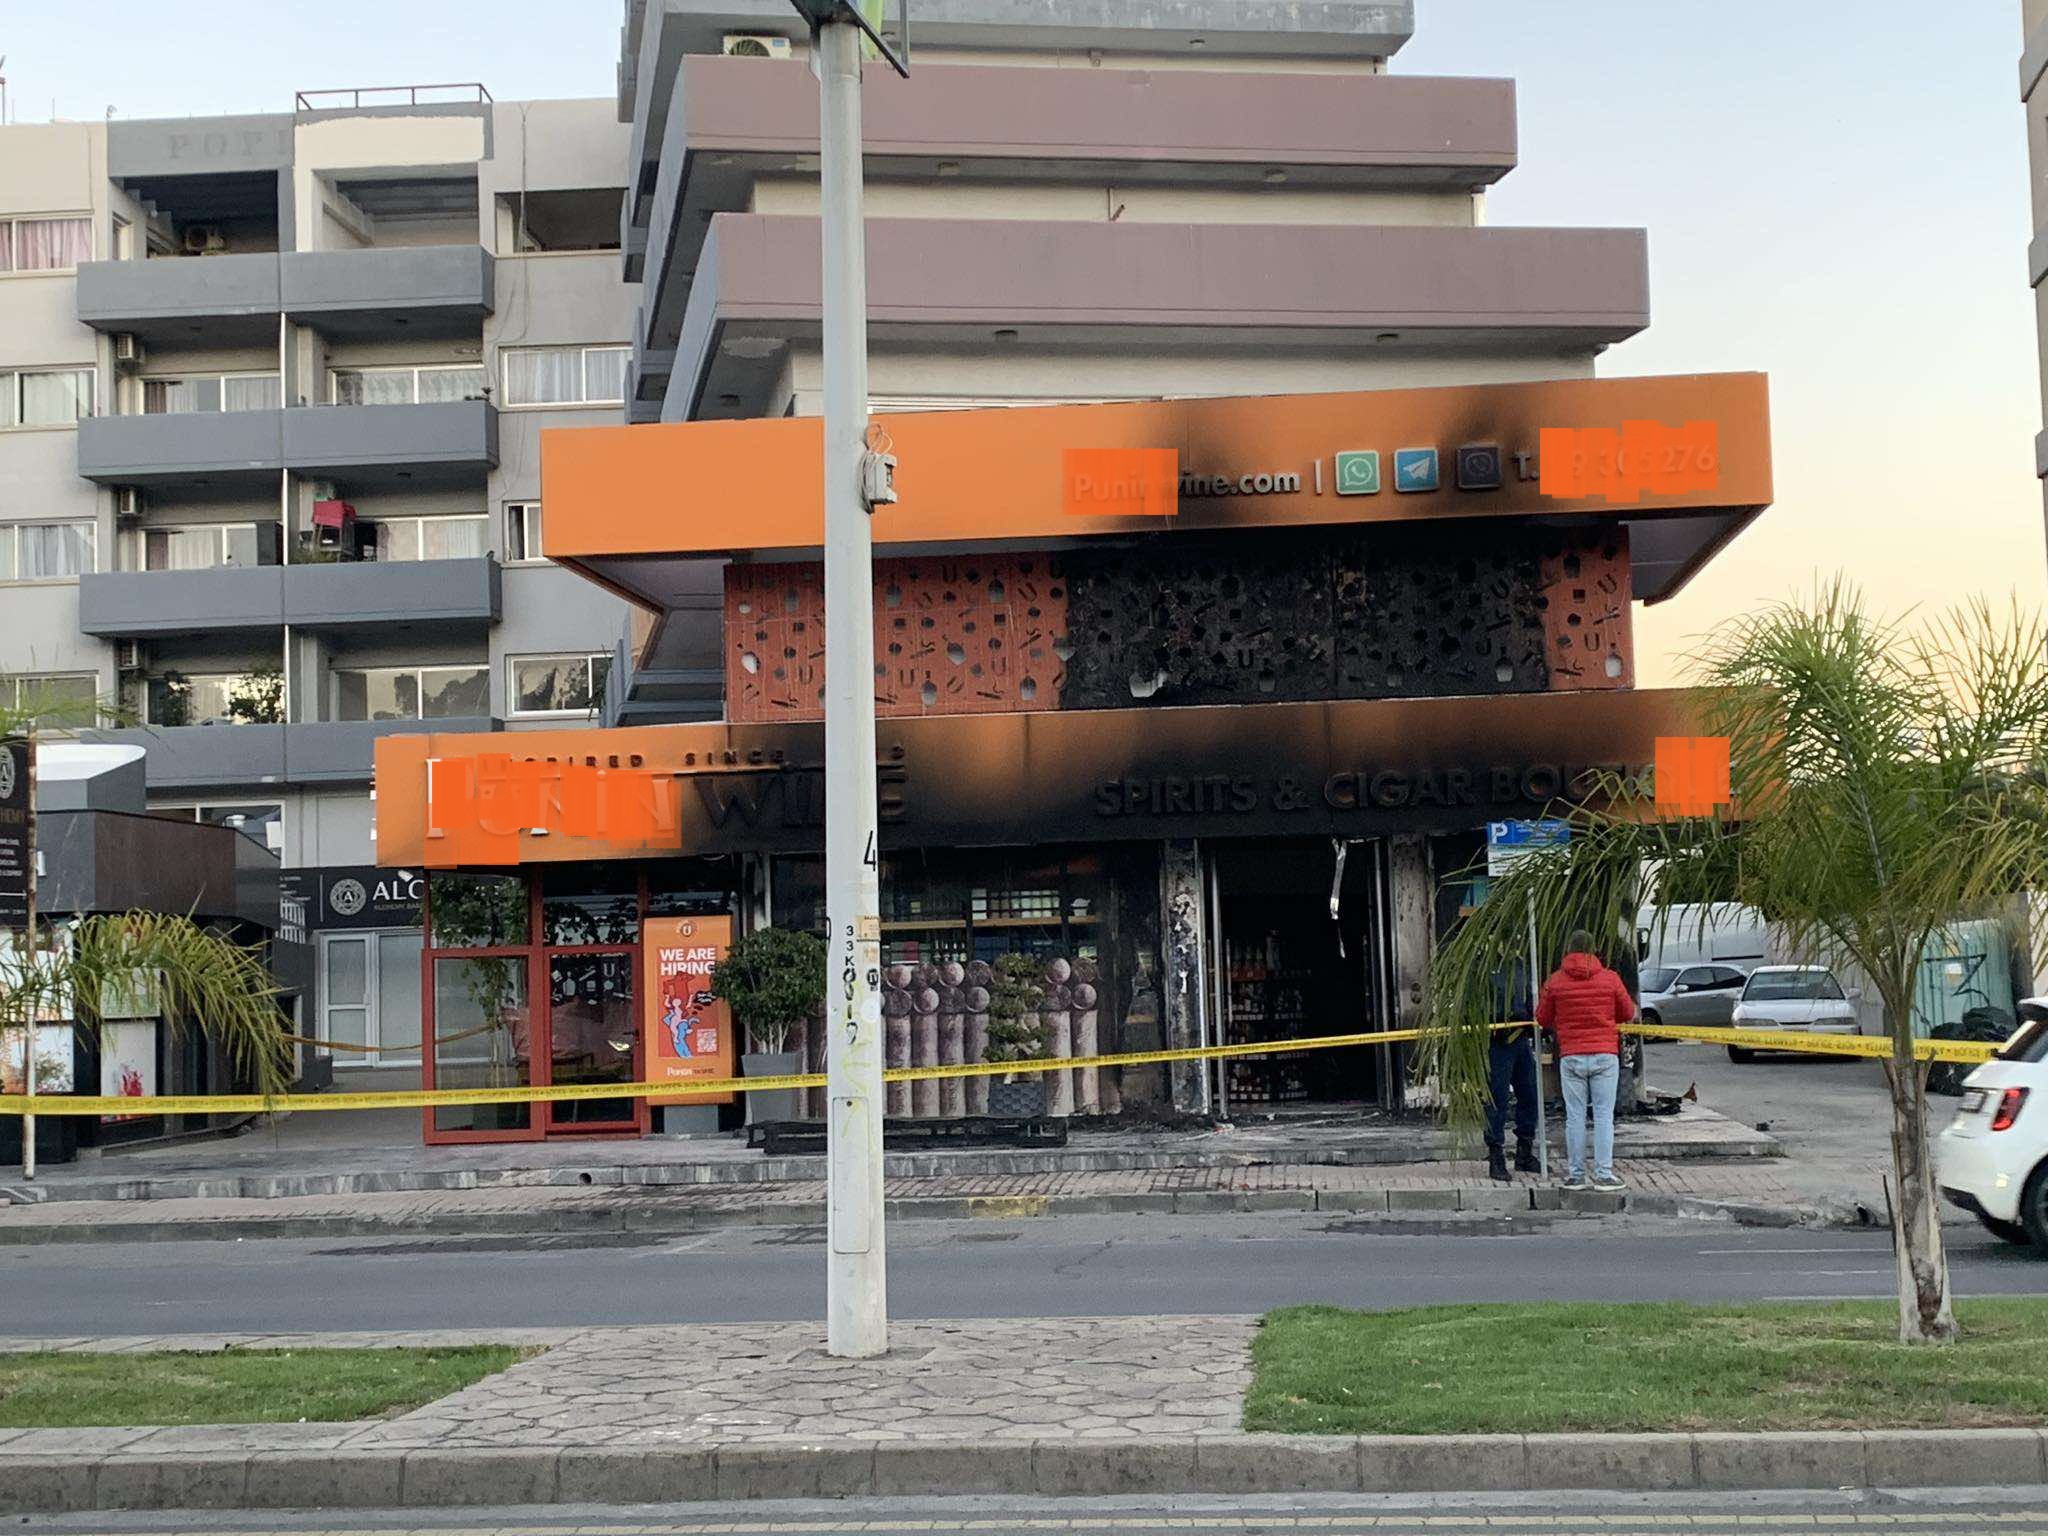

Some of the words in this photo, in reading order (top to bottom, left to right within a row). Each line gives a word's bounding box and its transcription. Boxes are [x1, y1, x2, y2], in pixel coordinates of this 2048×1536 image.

[1096, 774, 1257, 815] SPIRITS
[1273, 774, 1312, 812] &
[1324, 767, 1474, 809] CIGAR
[1491, 822, 1508, 844] P
[863, 830, 877, 872] 4
[660, 948, 685, 962] WE
[686, 946, 717, 961] ARE
